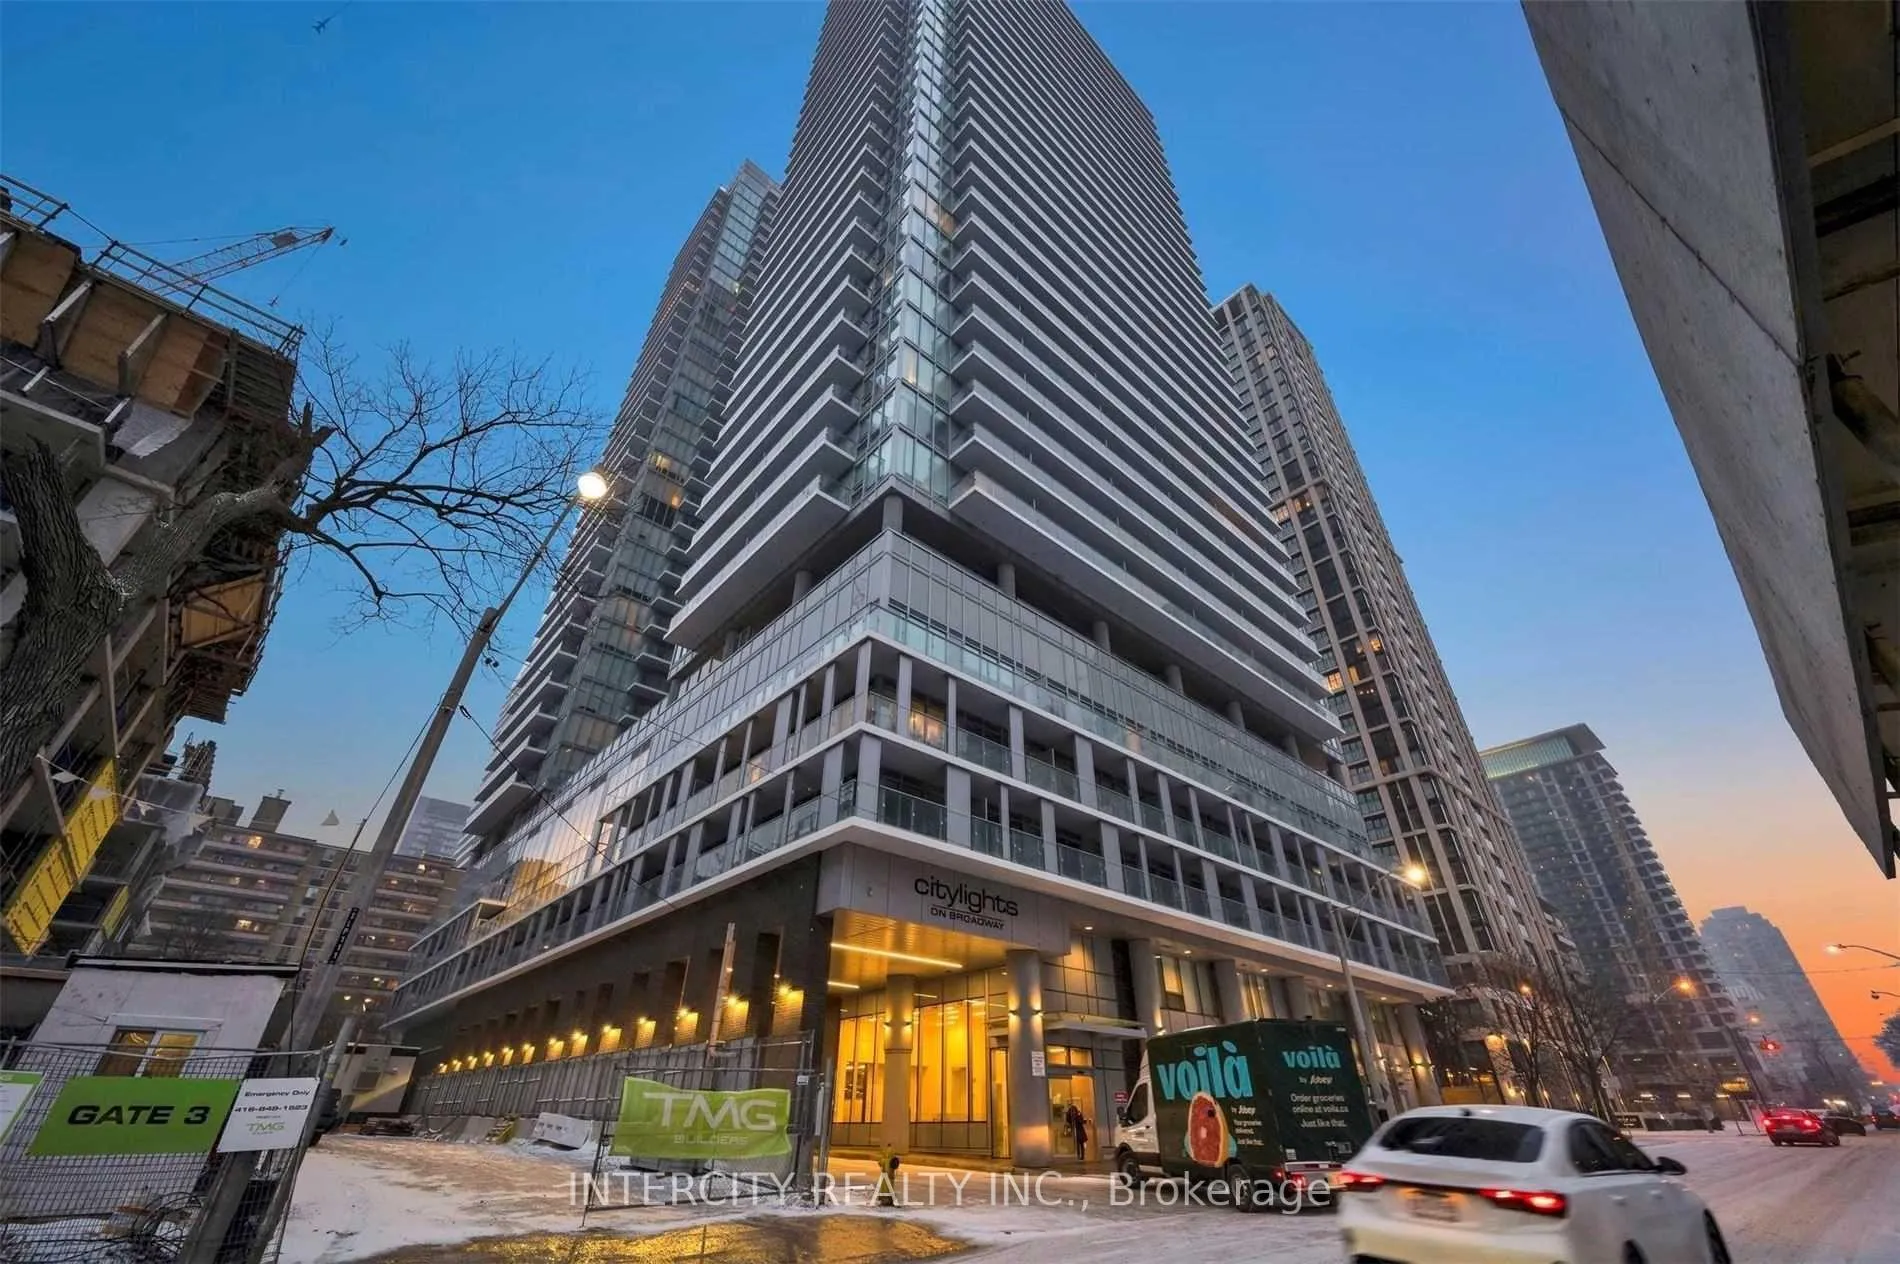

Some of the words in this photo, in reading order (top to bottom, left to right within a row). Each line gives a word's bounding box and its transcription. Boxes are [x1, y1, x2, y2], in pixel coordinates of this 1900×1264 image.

[914, 875, 1019, 917] citylights
[930, 907, 947, 918] ON
[949, 911, 1005, 930] BROADWAY
[1283, 1045, 1341, 1069] voilà
[1156, 1040, 1253, 1100] voilà
[1291, 1093, 1311, 1102] Order
[67, 1105, 175, 1125] GATE
[184, 1105, 211, 1125] 3
[643, 1092, 777, 1131] TMG
[246, 1121, 286, 1132] TMG
[674, 1134, 750, 1145] BUILDERS
